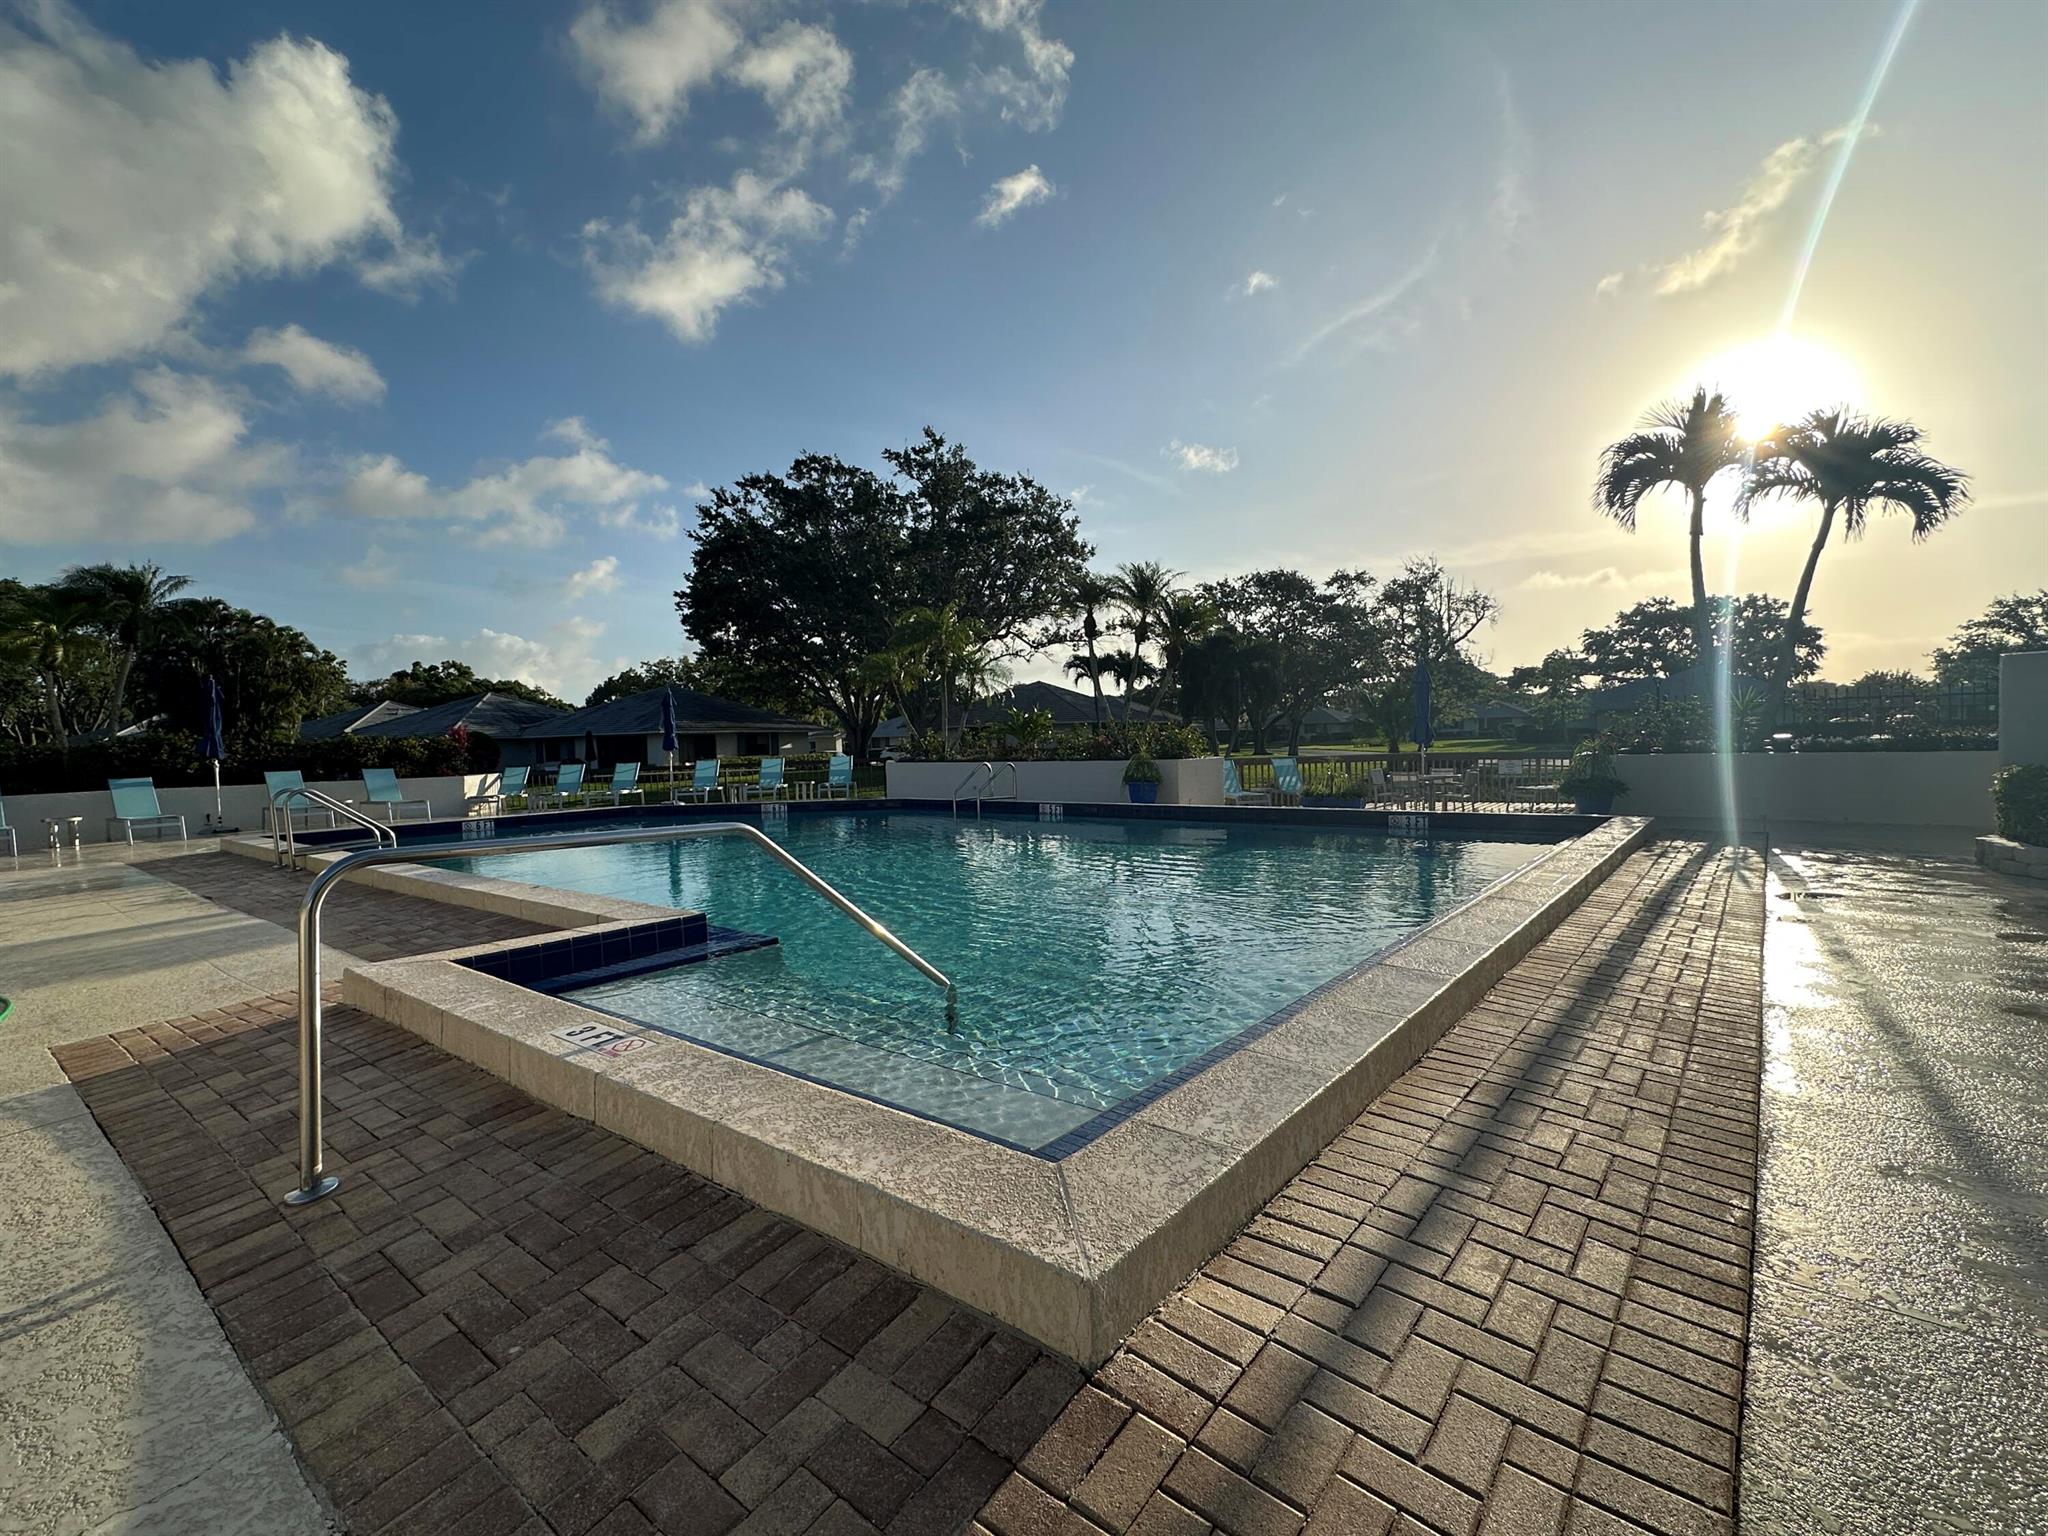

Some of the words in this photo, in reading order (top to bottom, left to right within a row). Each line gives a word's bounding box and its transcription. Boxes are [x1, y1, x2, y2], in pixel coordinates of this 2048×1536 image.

[1405, 816, 1411, 828] 3
[1415, 816, 1427, 828] FT
[566, 1025, 597, 1037] 3
[579, 1031, 624, 1047] FT
